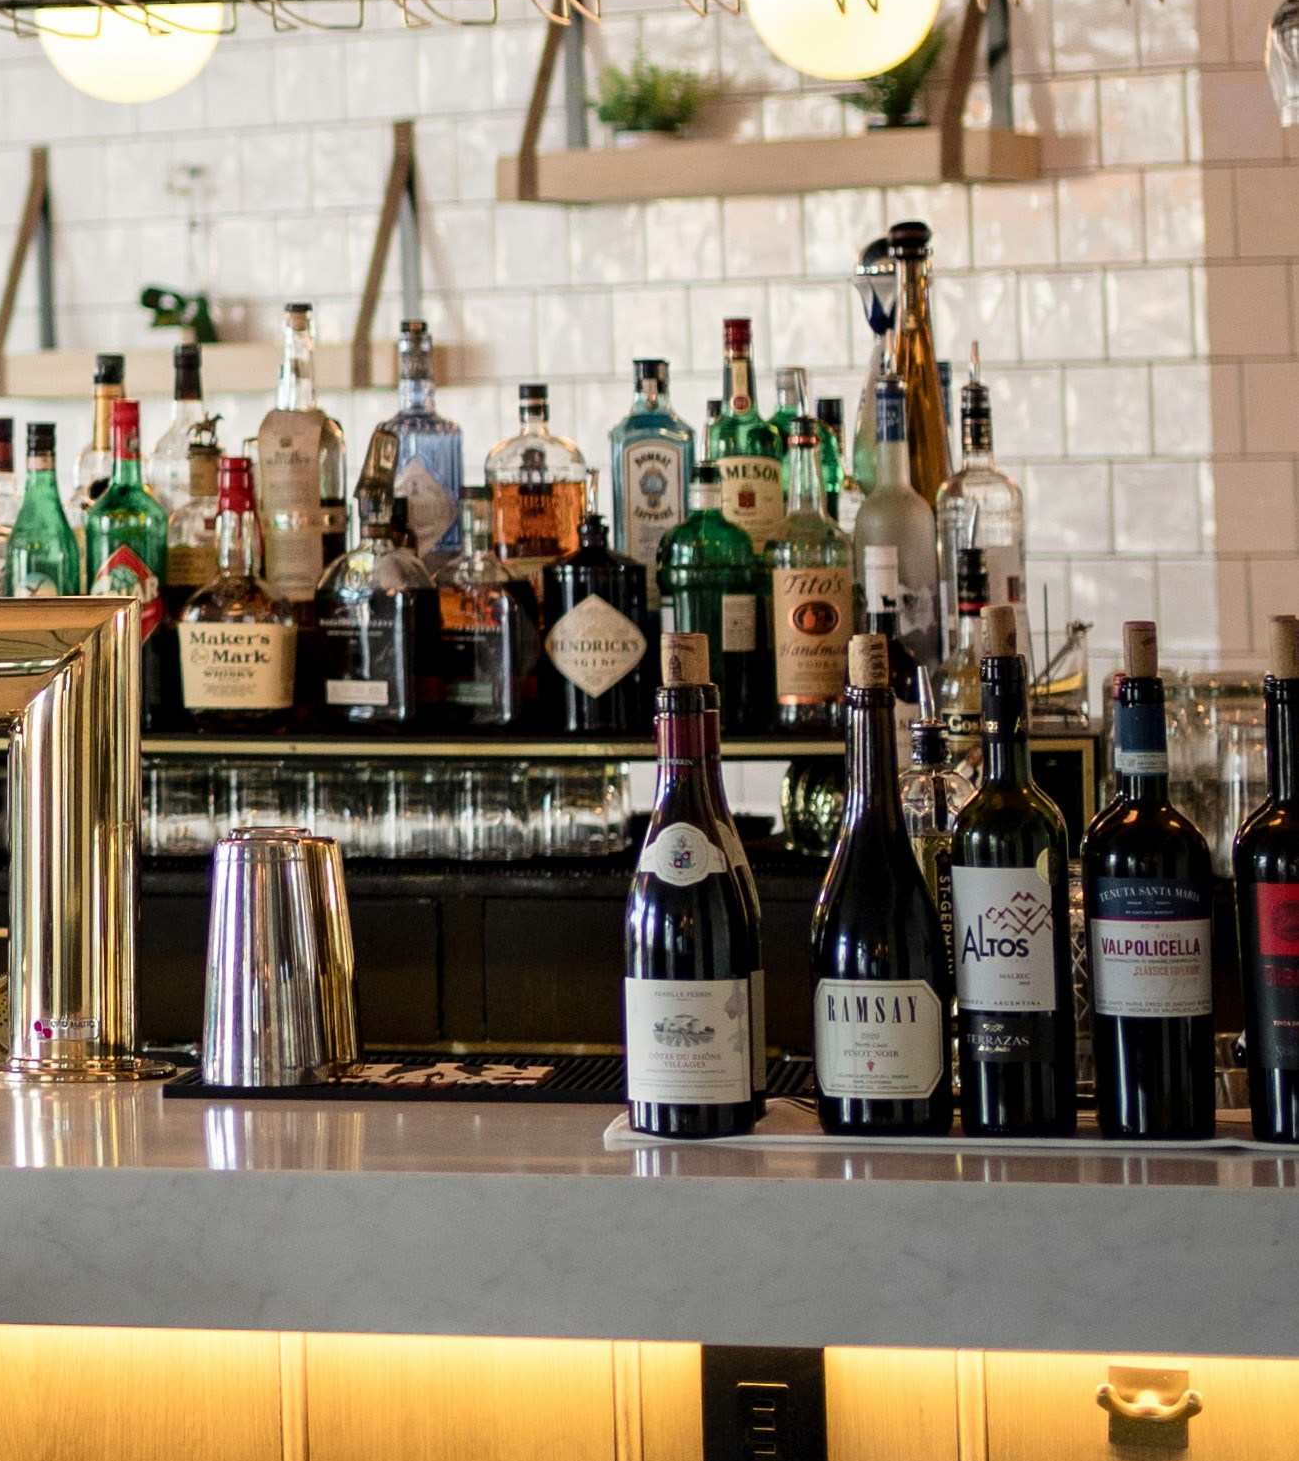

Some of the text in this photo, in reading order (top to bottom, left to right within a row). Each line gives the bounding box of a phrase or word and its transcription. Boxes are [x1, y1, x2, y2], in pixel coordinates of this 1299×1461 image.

[634, 450, 672, 469] BOMBAY
[724, 463, 780, 483] MESON
[783, 572, 846, 595] Tito's
[189, 631, 271, 645] Maker's
[212, 648, 271, 664] Mark
[780, 640, 844, 656] Handma
[1099, 886, 1200, 902] TENUTA SANTA MARIA
[1101, 937, 1202, 956] VALPOLICELLA
[827, 994, 919, 1024] RAMSAY
[966, 1033, 1030, 1046] TERRAZAS
[648, 1051, 676, 1061] CÔTES
[676, 1052, 690, 1061] DU
[843, 1049, 900, 1058] PINOT NOIR
[663, 1061, 707, 1069] VILLAGES
